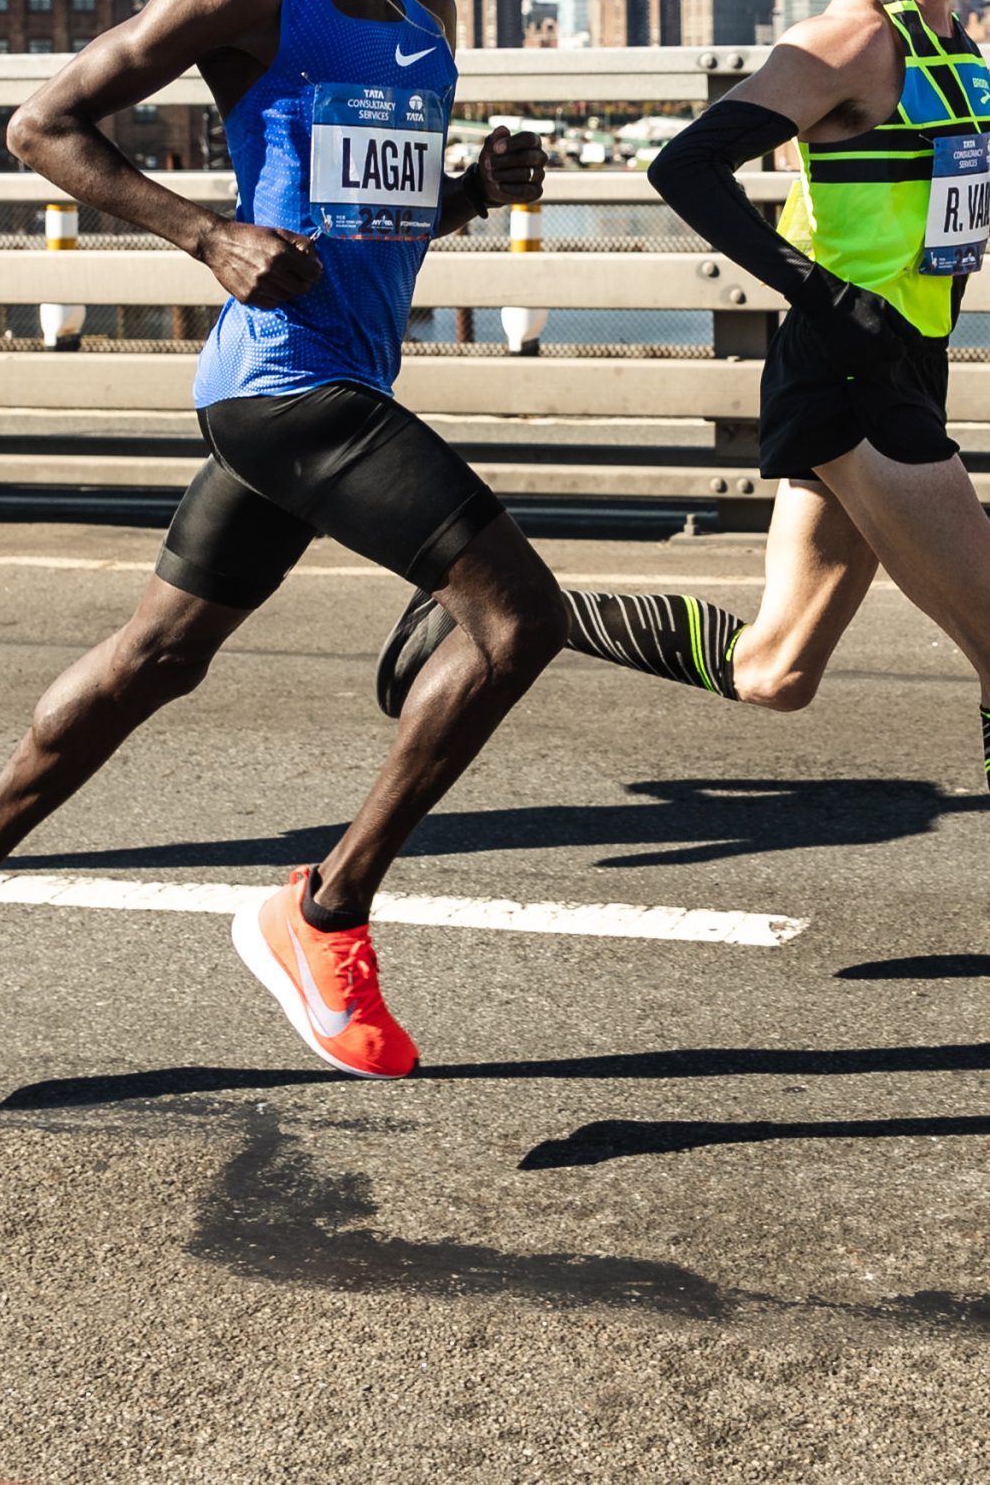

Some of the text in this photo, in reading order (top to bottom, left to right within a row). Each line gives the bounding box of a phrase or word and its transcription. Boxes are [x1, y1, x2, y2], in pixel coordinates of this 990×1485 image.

[364, 89, 384, 99] TATA
[347, 99, 396, 111] CONSULTANCY
[358, 110, 389, 121] SERVICES
[406, 112, 424, 122] TATA
[342, 137, 428, 192] LAGAT
[944, 187, 963, 233] R.
